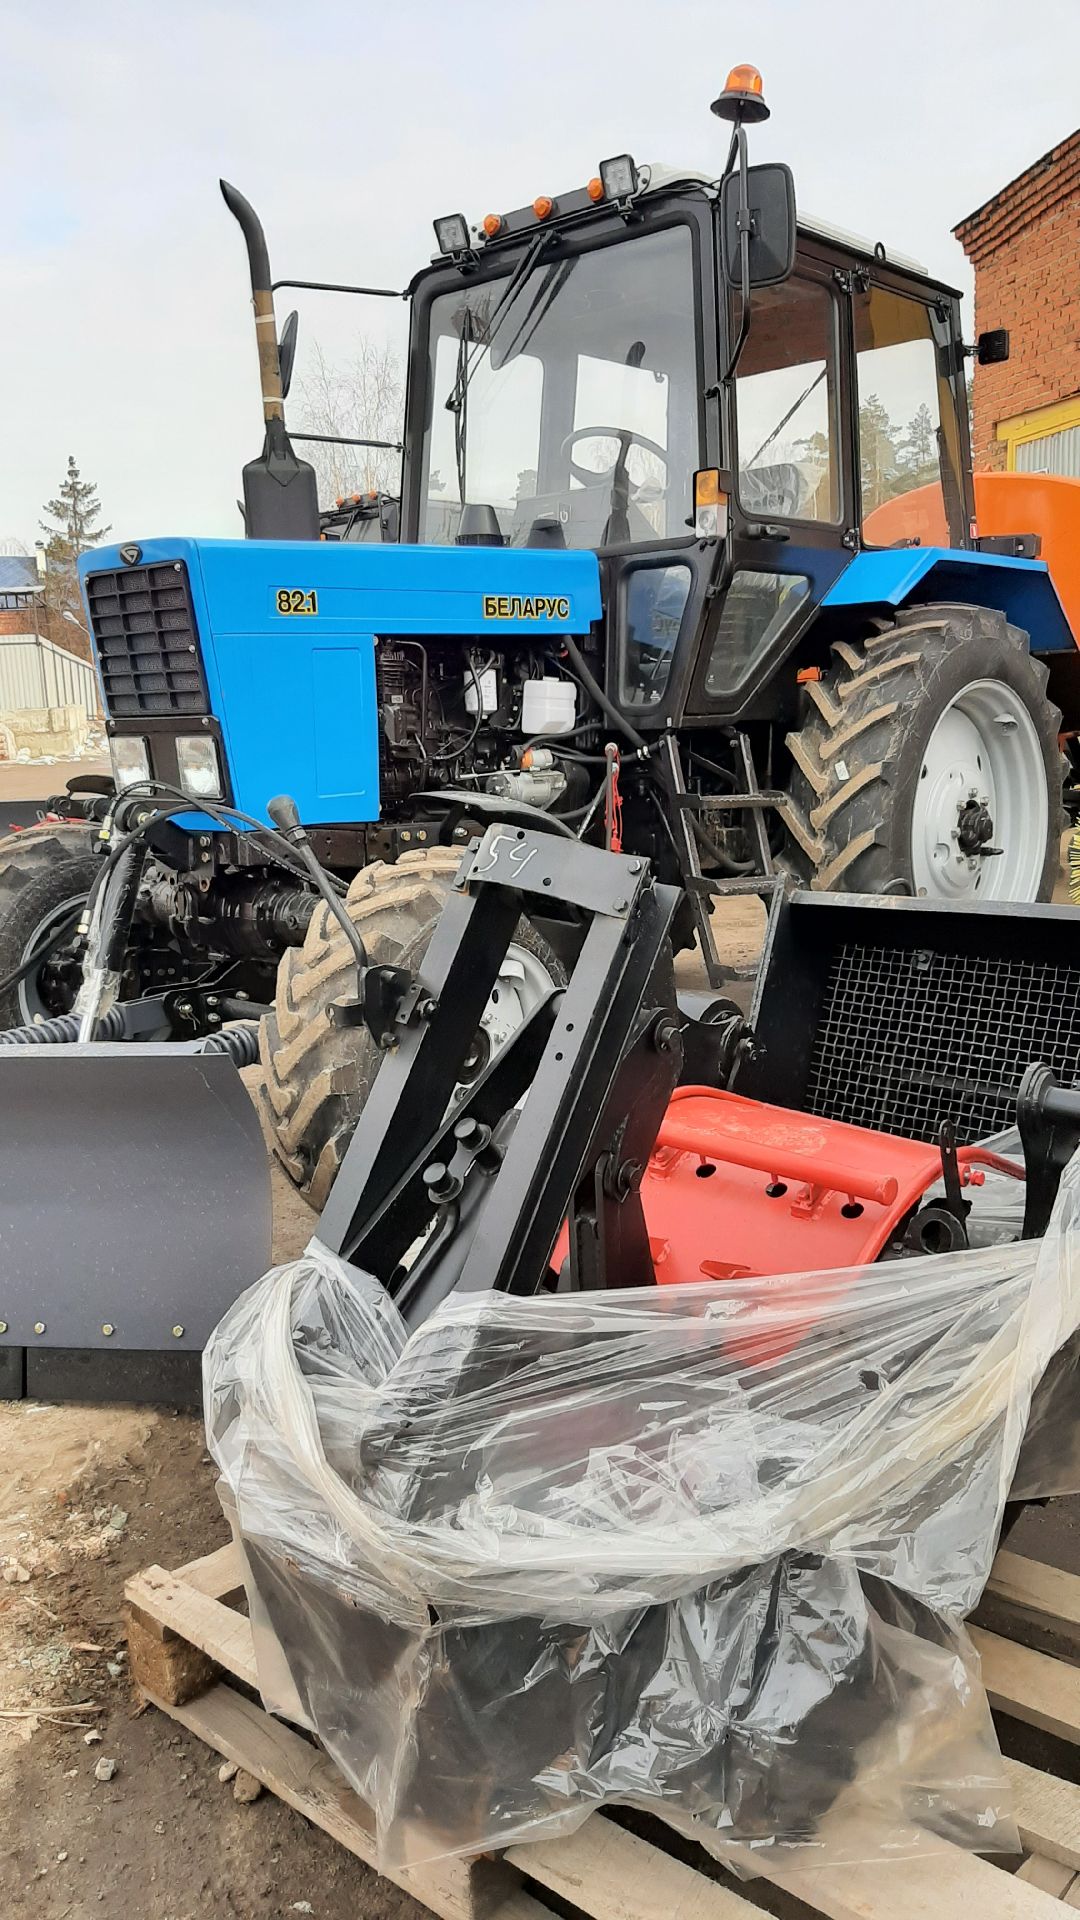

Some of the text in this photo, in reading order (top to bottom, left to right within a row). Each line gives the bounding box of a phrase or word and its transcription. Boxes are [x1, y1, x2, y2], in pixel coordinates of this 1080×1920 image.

[277, 589, 318, 614] 82.1
[484, 596, 569, 619] БЕЛАРУС
[477, 835, 538, 878] 54
